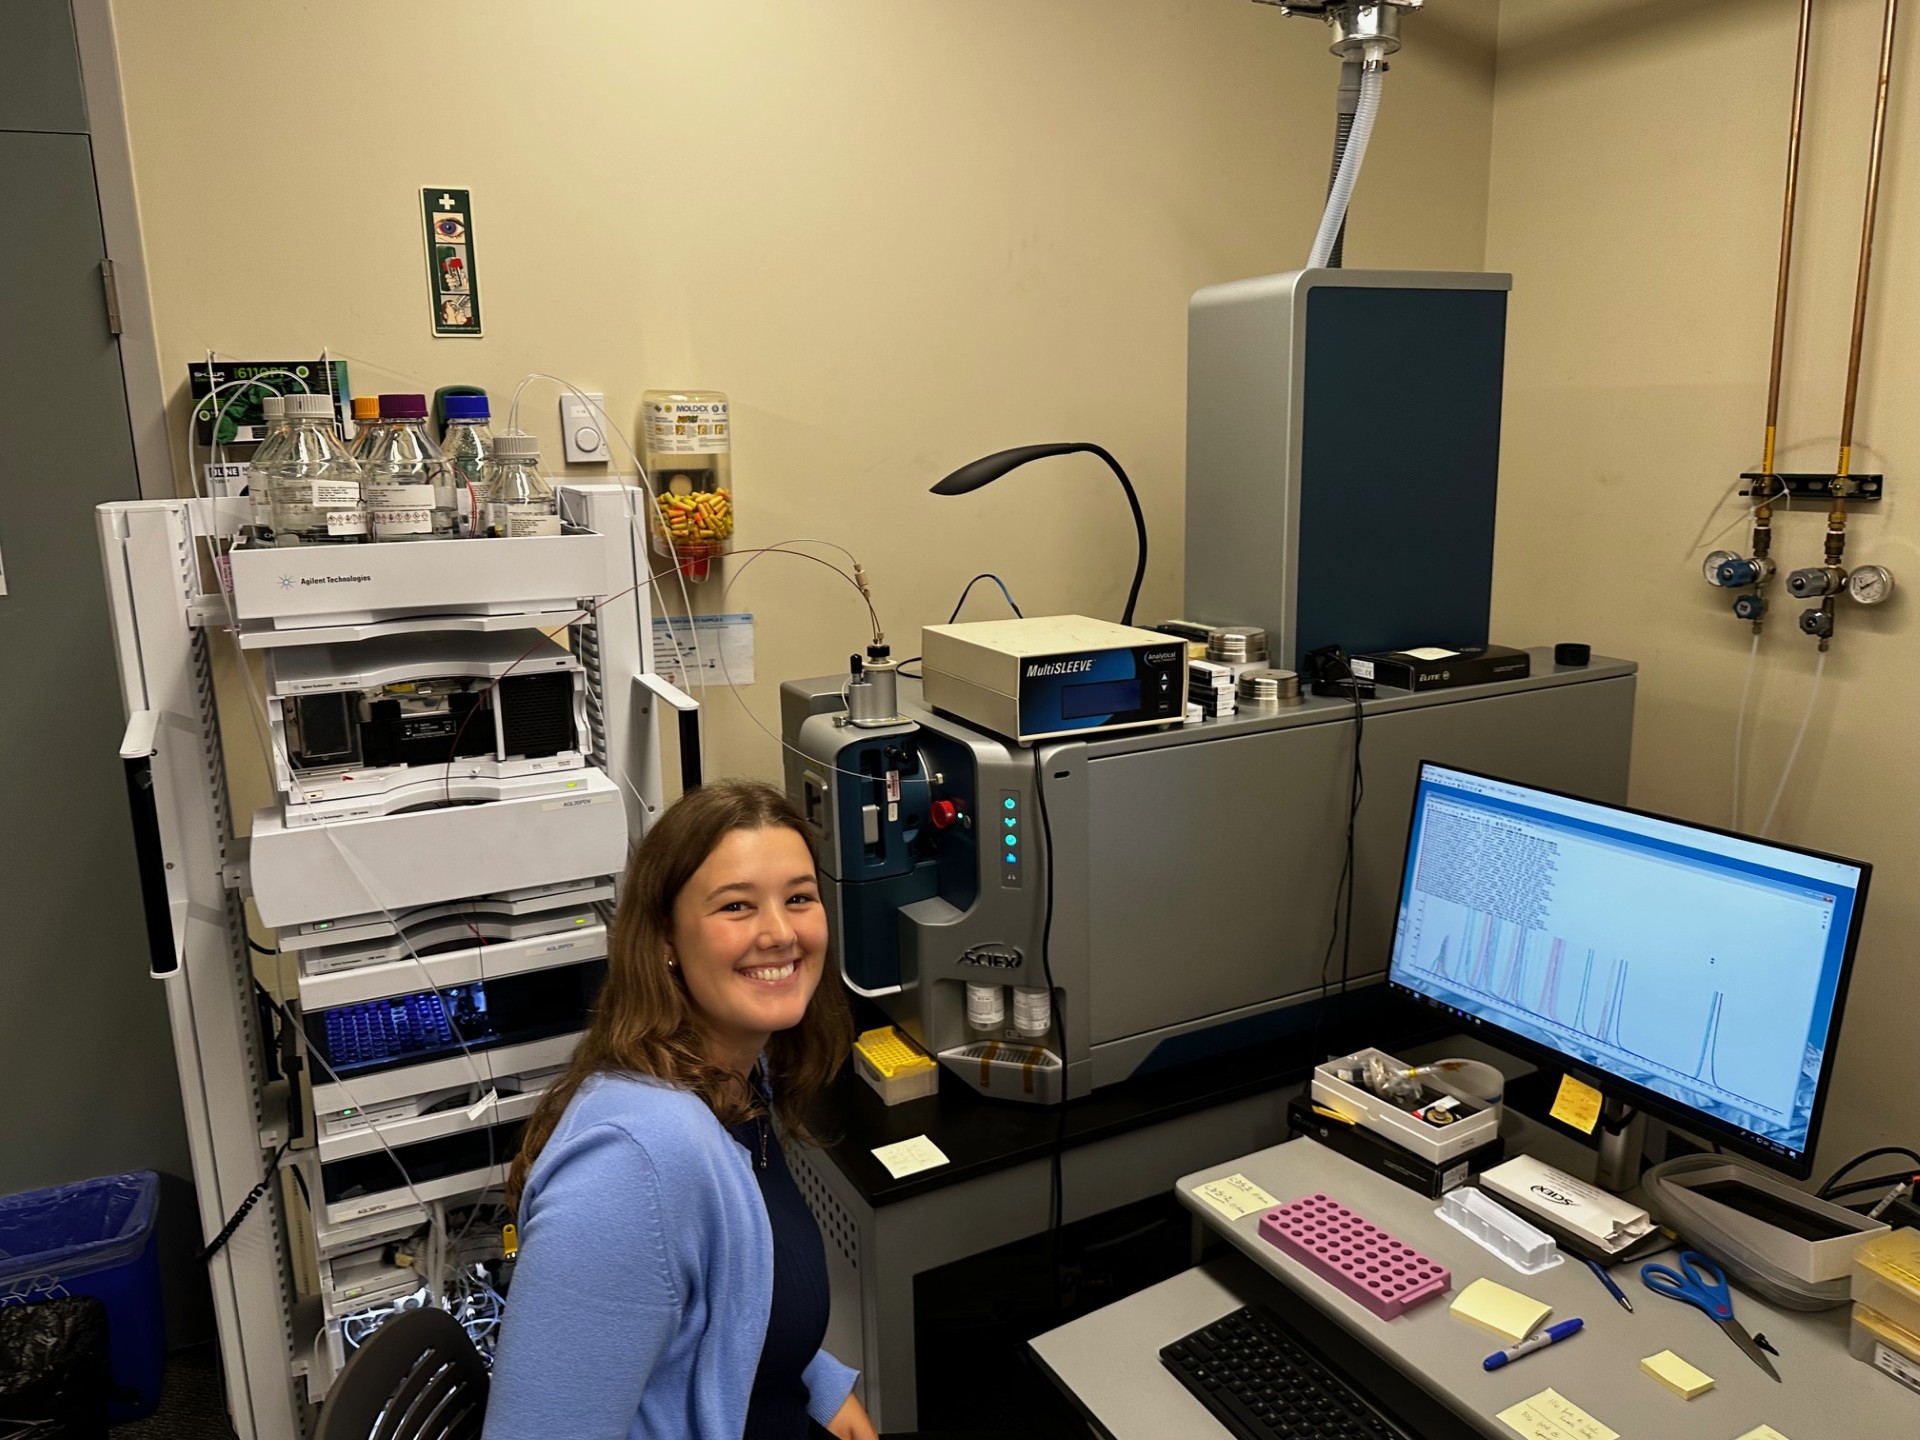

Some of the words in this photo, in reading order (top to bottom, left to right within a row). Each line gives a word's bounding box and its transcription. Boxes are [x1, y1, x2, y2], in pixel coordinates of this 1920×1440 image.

[676, 404, 709, 412] MOLDEX
[210, 466, 239, 477] ULNE
[300, 577, 326, 586] Agilent
[326, 574, 371, 584] Technologies
[1148, 651, 1176, 661] Analytical
[1026, 659, 1093, 678] MultiSLEEVE
[963, 948, 1018, 969] SCIEX
[1537, 1185, 1573, 1206] SCIEX
